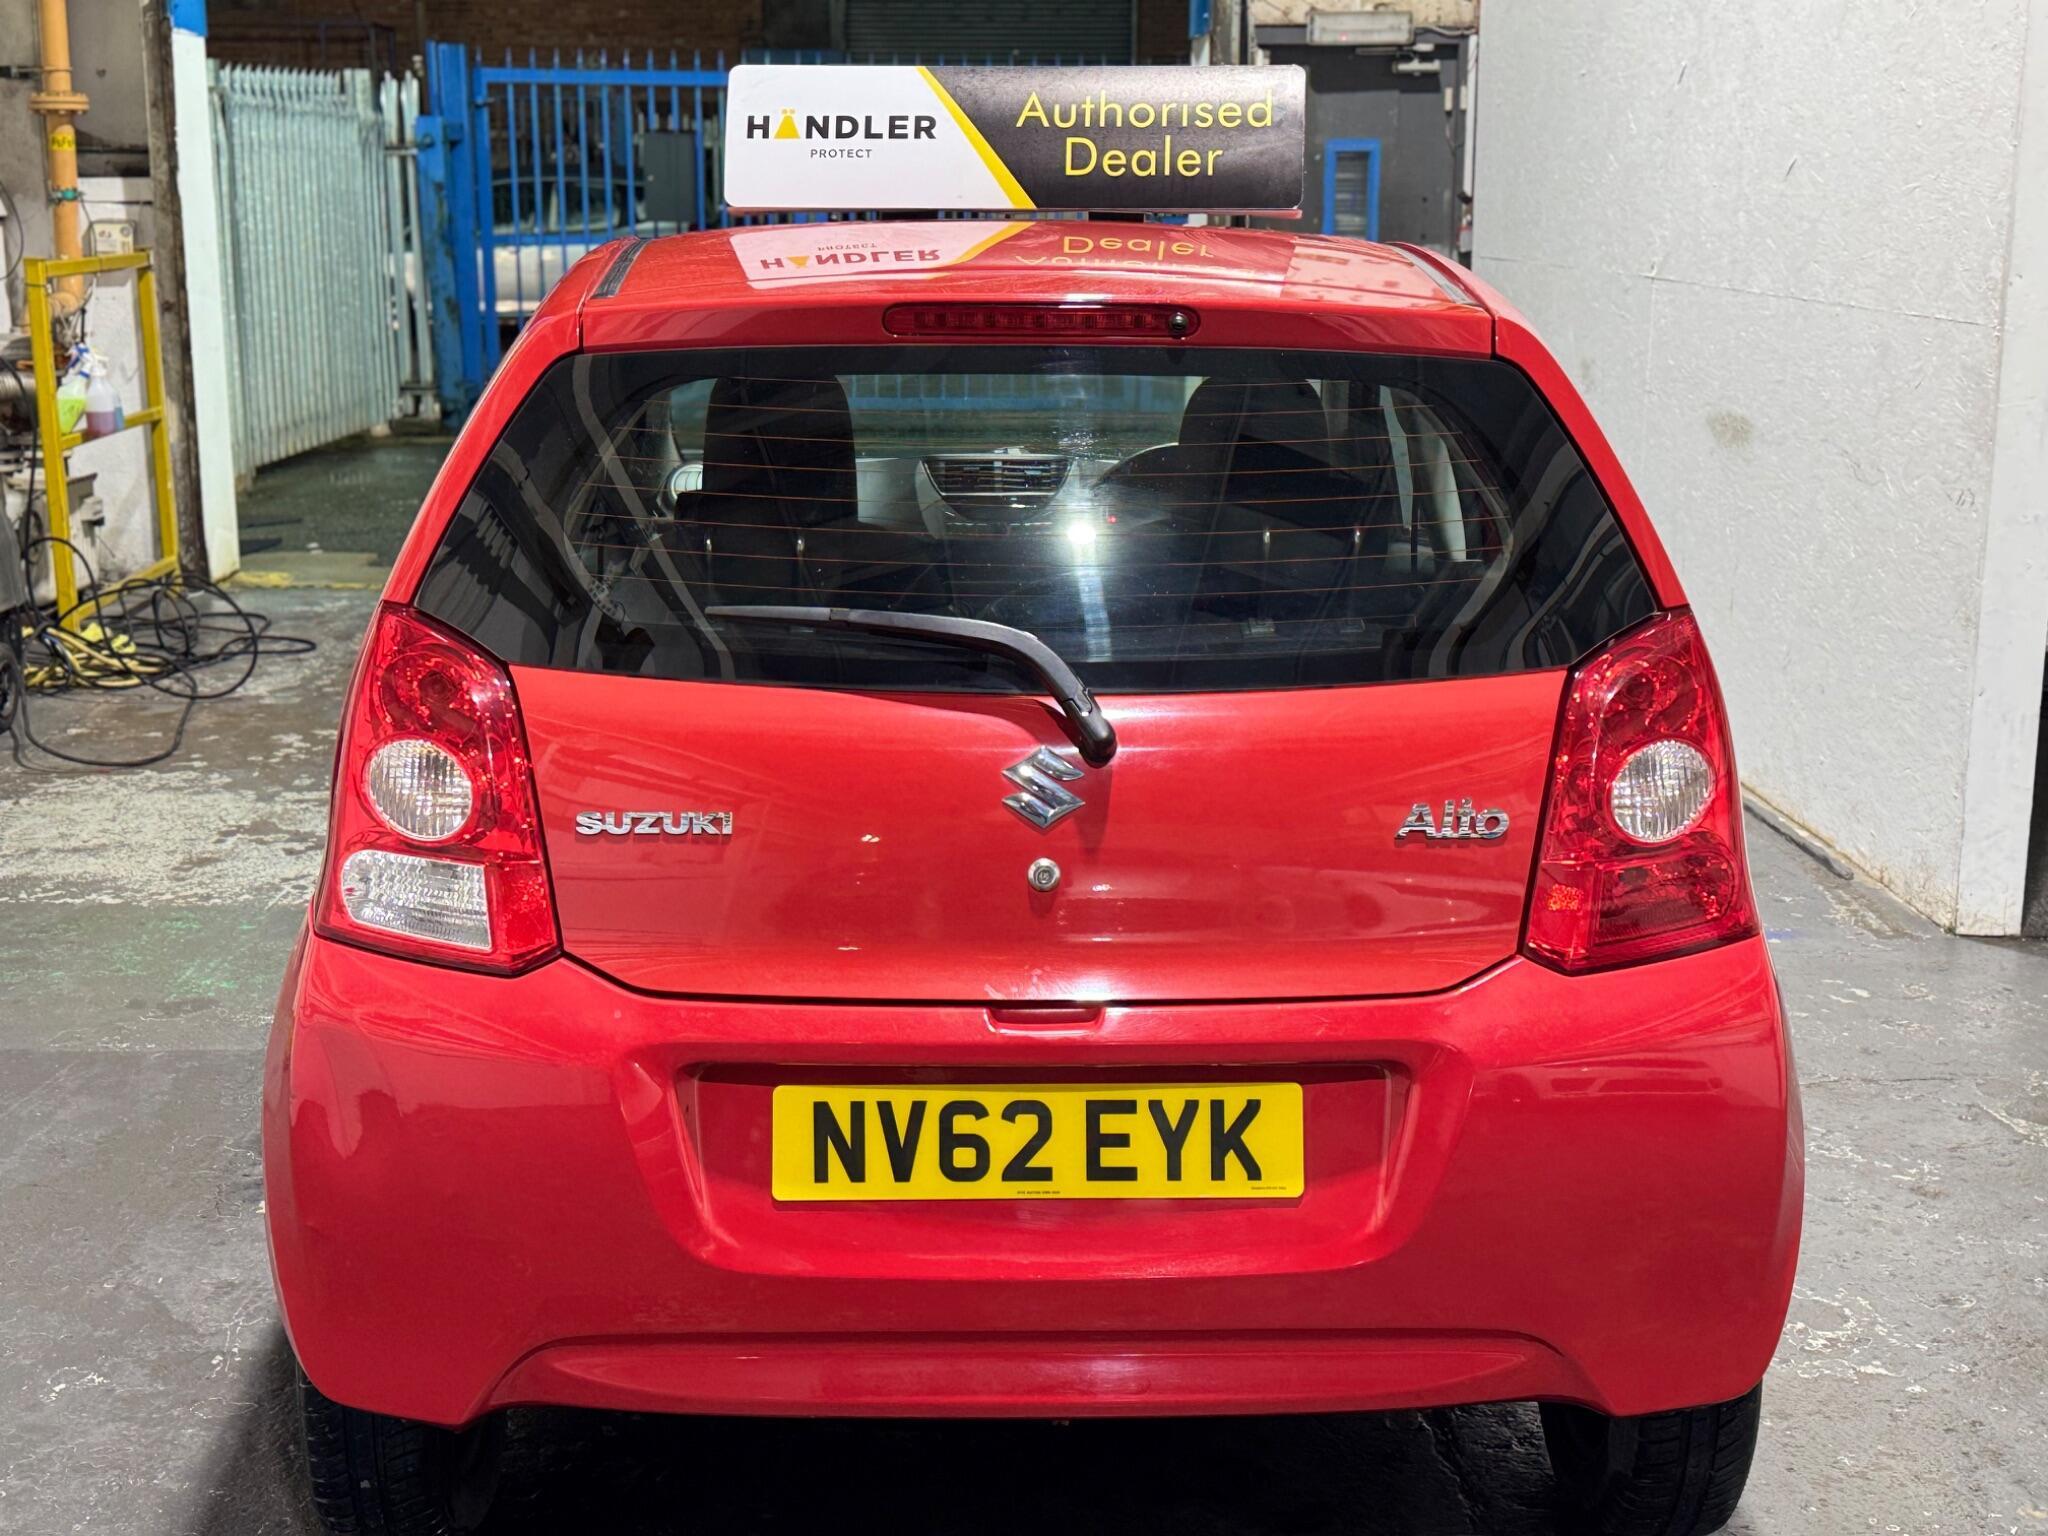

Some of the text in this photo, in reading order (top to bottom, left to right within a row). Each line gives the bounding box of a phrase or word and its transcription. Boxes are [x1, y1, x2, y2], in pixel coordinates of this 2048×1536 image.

[1015, 88, 1273, 128] Authorised
[810, 148, 873, 158] PROTECT
[1064, 134, 1224, 177] Dealer
[575, 811, 733, 835] SUZUKI
[1395, 798, 1510, 839] Alto
[812, 1098, 1263, 1184] NV62 EYK
